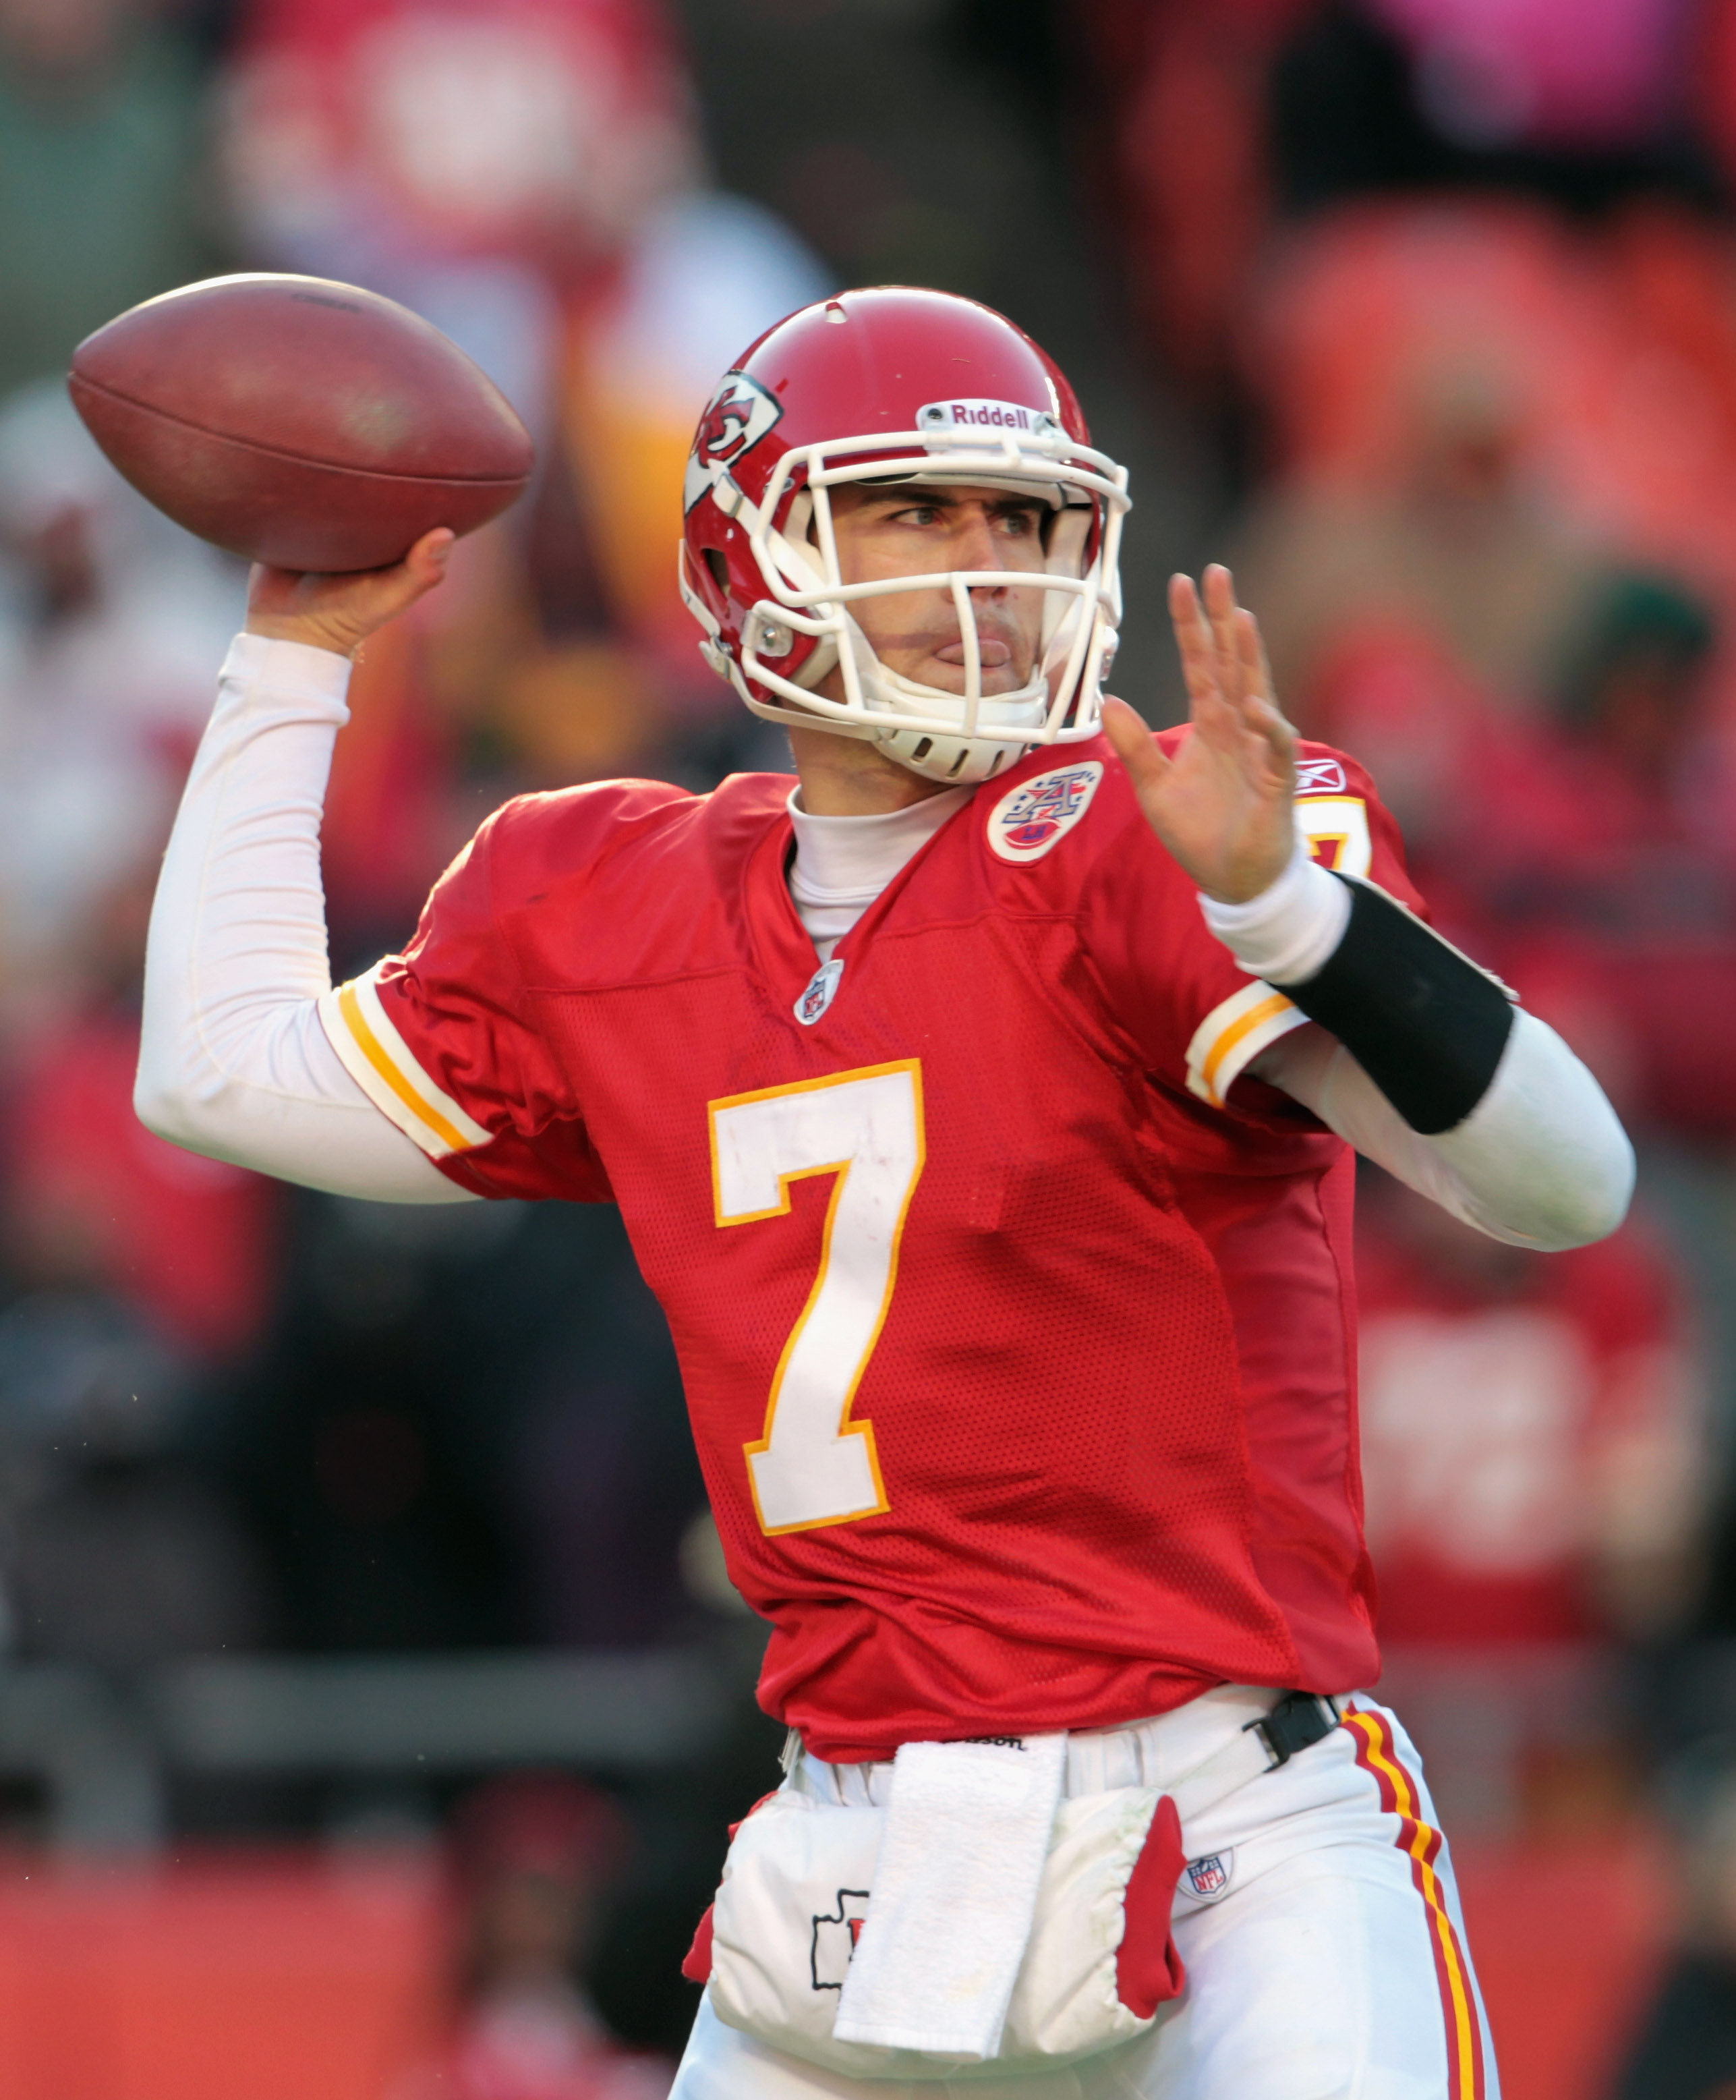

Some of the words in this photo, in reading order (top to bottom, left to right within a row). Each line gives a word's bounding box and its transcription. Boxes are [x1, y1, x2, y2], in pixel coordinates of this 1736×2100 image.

[951, 404, 1029, 430] Riddell
[707, 1058, 927, 1536] 7
[1194, 1870, 1225, 1890] NFL
